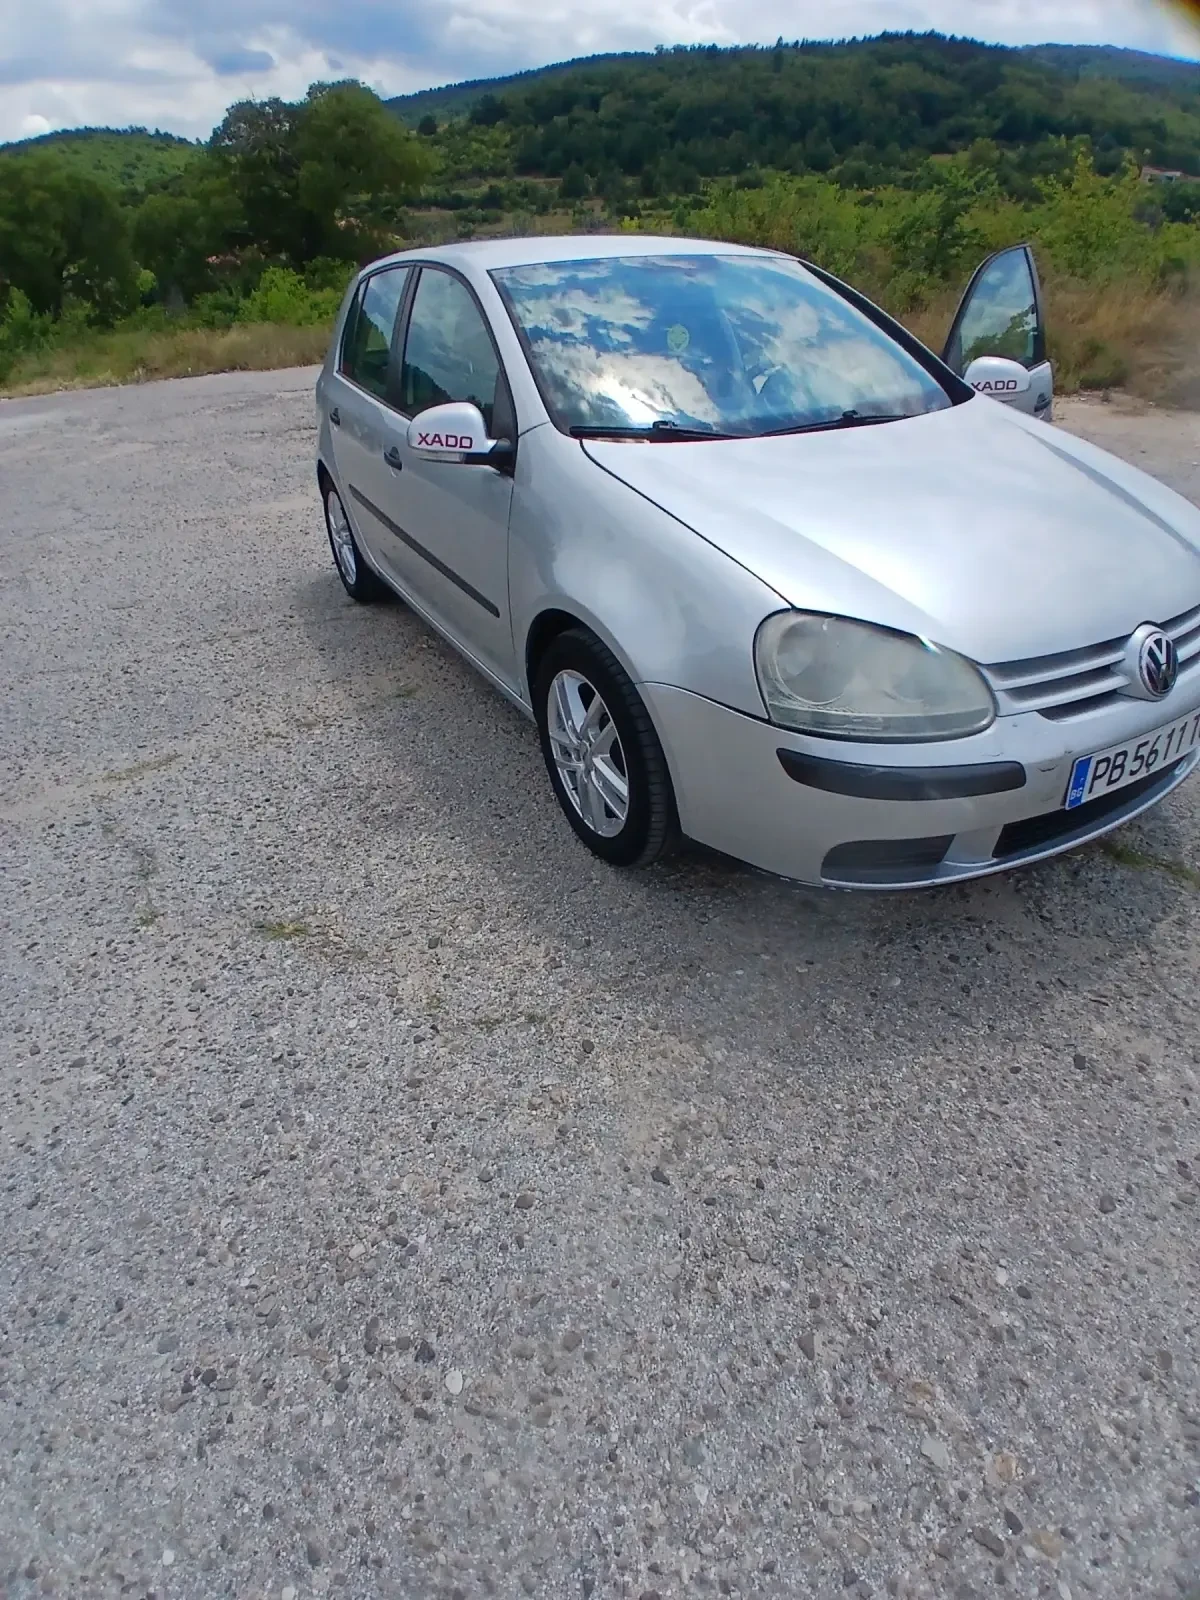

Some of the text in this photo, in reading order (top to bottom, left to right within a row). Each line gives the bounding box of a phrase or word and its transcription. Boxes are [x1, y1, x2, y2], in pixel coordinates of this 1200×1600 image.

[970, 380, 1018, 392] XADO
[417, 432, 474, 449] XADO
[1088, 749, 1129, 795] PB
[1128, 720, 1189, 777] 5611
[1069, 786, 1084, 801] BG
